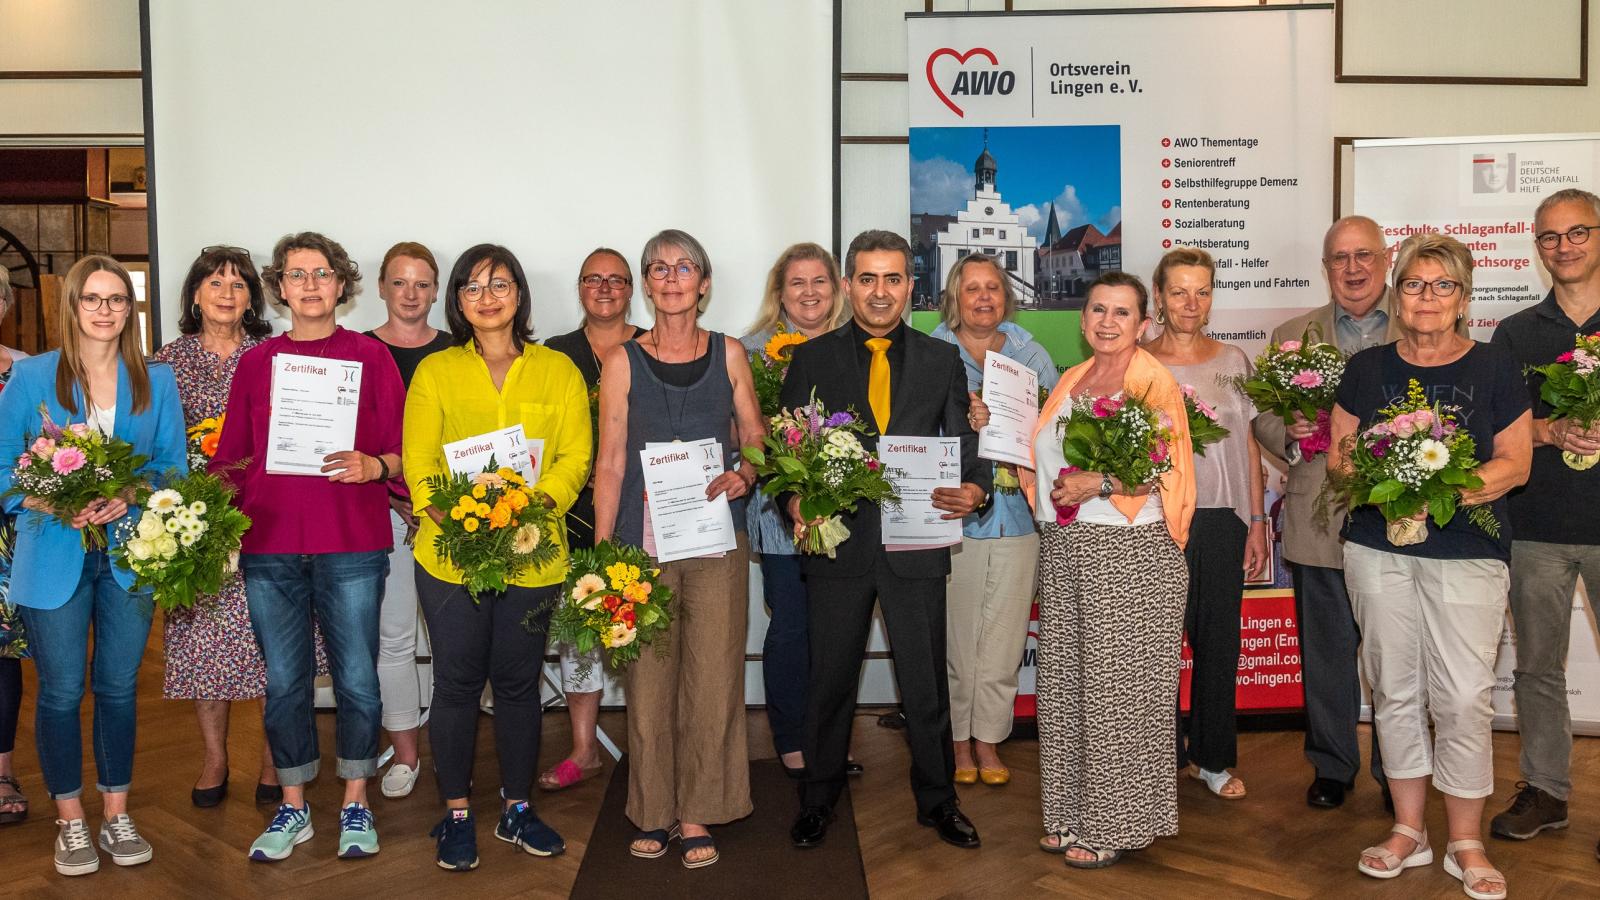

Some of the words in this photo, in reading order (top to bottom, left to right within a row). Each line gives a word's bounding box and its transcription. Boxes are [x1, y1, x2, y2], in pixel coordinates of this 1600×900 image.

[1050, 61, 1131, 77] Ortsverein
[951, 70, 1015, 96] AWO
[1050, 80, 1103, 97] Lingen
[1110, 82, 1125, 94] e.
[1128, 79, 1143, 93] V.
[1174, 138, 1198, 147] AWO
[1201, 137, 1259, 149] Thementage
[1174, 157, 1236, 168] Seniorentreff
[1520, 167, 1560, 175] DEUTSCHE
[1174, 178, 1258, 189] Selbsthilfegruppe
[1260, 177, 1298, 187] Demenz
[1520, 175, 1580, 184] SCHLAGANFALL
[1174, 198, 1250, 210] Rentenberatung
[1174, 218, 1245, 230] Sozialberatung
[1241, 258, 1269, 268] Helfer
[1254, 278, 1271, 288] und
[1274, 277, 1310, 288] Fahrten
[1497, 294, 1540, 302] Schlaganfall
[284, 362, 327, 376] Zertifikat
[992, 359, 1019, 377] Zertifikat
[453, 441, 495, 460] Zertifikat
[887, 443, 927, 453] Zertifikat
[649, 451, 689, 466] Zertifikat
[1240, 616, 1281, 632] Lingen
